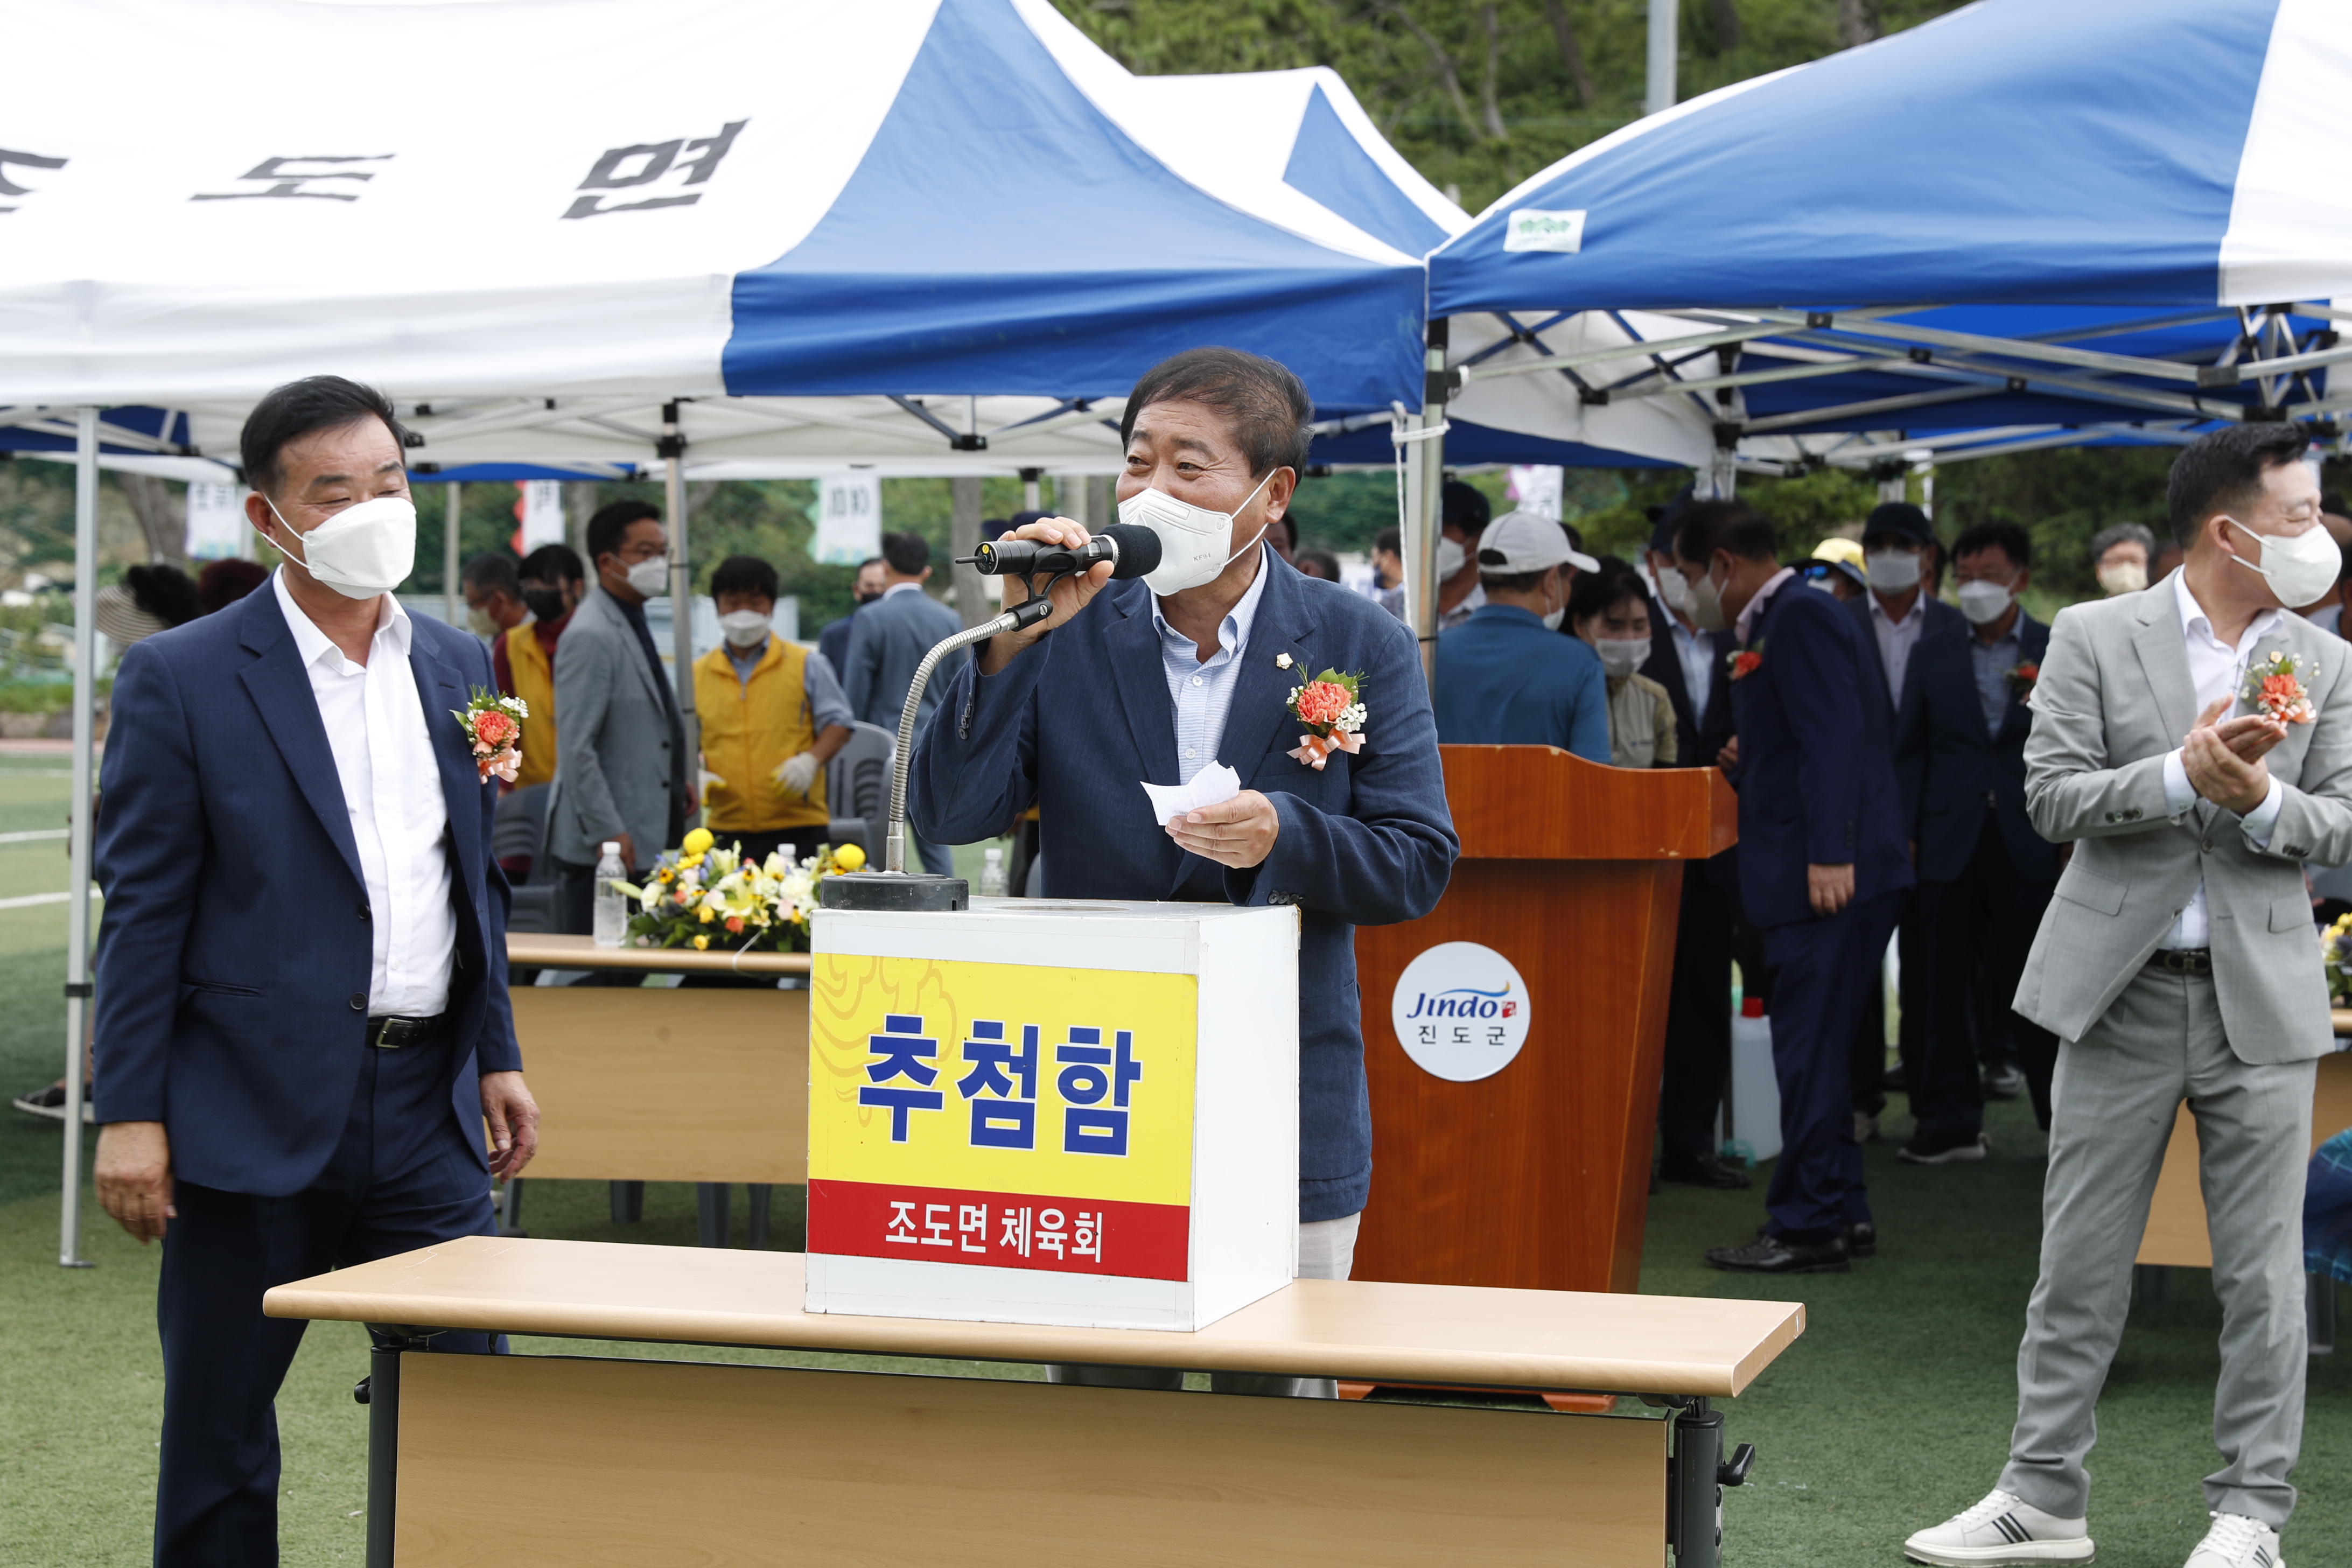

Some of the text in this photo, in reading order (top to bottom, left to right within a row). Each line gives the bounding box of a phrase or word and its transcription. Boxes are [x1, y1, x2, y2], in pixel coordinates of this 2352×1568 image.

[1193, 552, 1211, 562] KF94
[1406, 993, 1498, 1019] Jindo
[858, 1013, 1143, 1157] 추첨함
[885, 1200, 1102, 1263] 조도면 체육회
